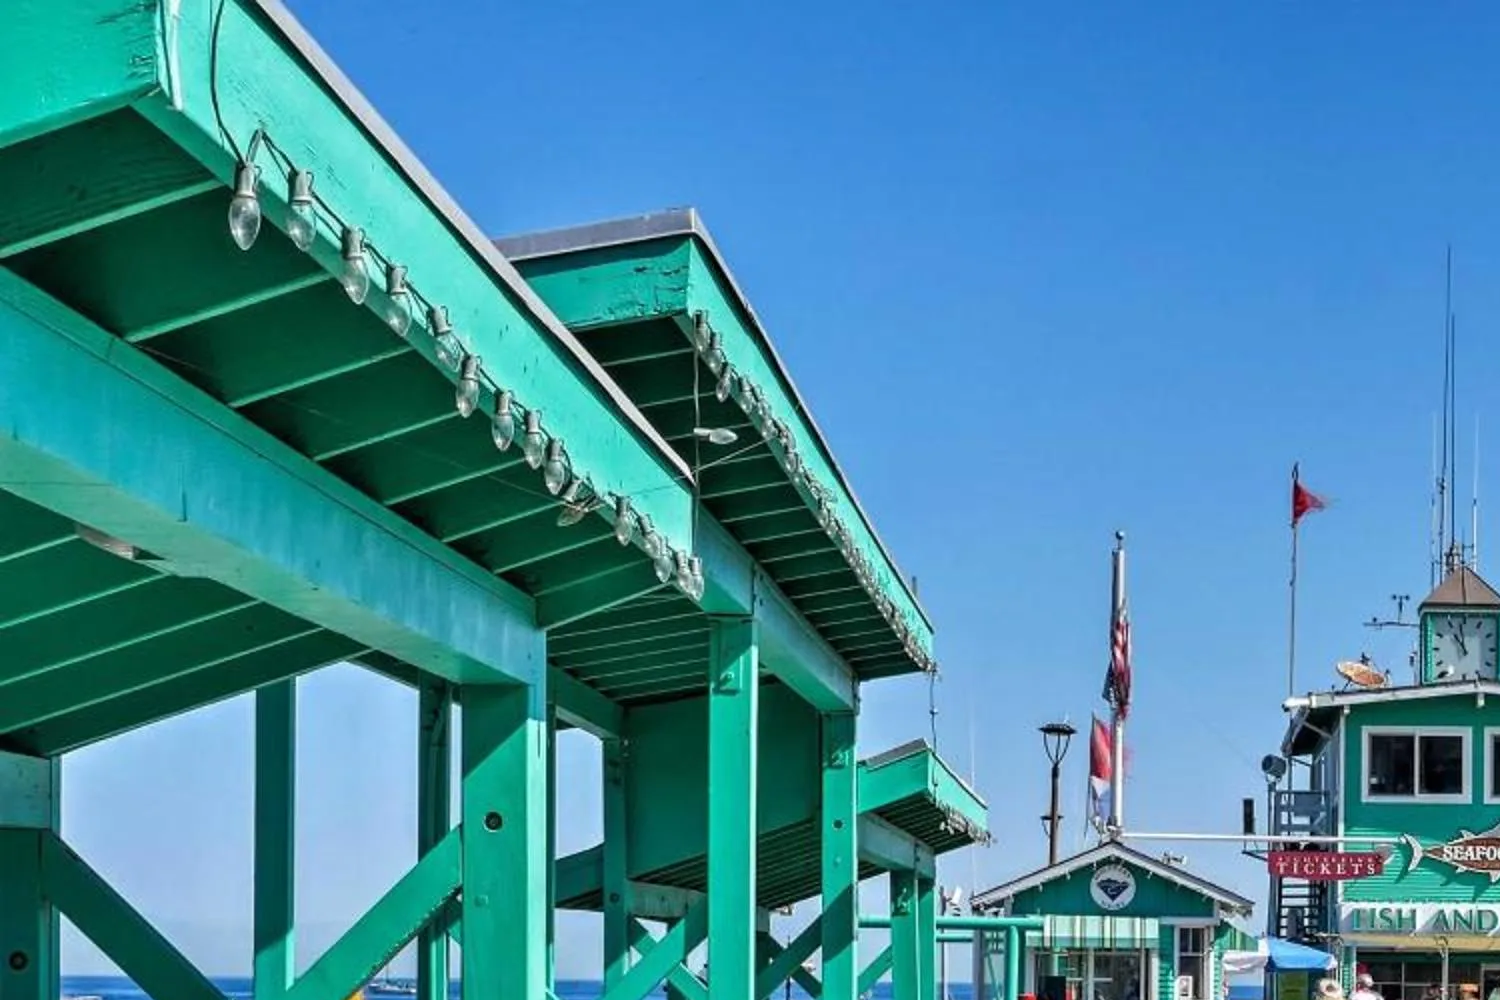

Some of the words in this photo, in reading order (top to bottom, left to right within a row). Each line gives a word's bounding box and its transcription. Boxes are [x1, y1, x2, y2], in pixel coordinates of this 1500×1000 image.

[1275, 862, 1376, 875] TICKETS
[1352, 907, 1417, 932] FISH
[1432, 907, 1499, 933] AND
